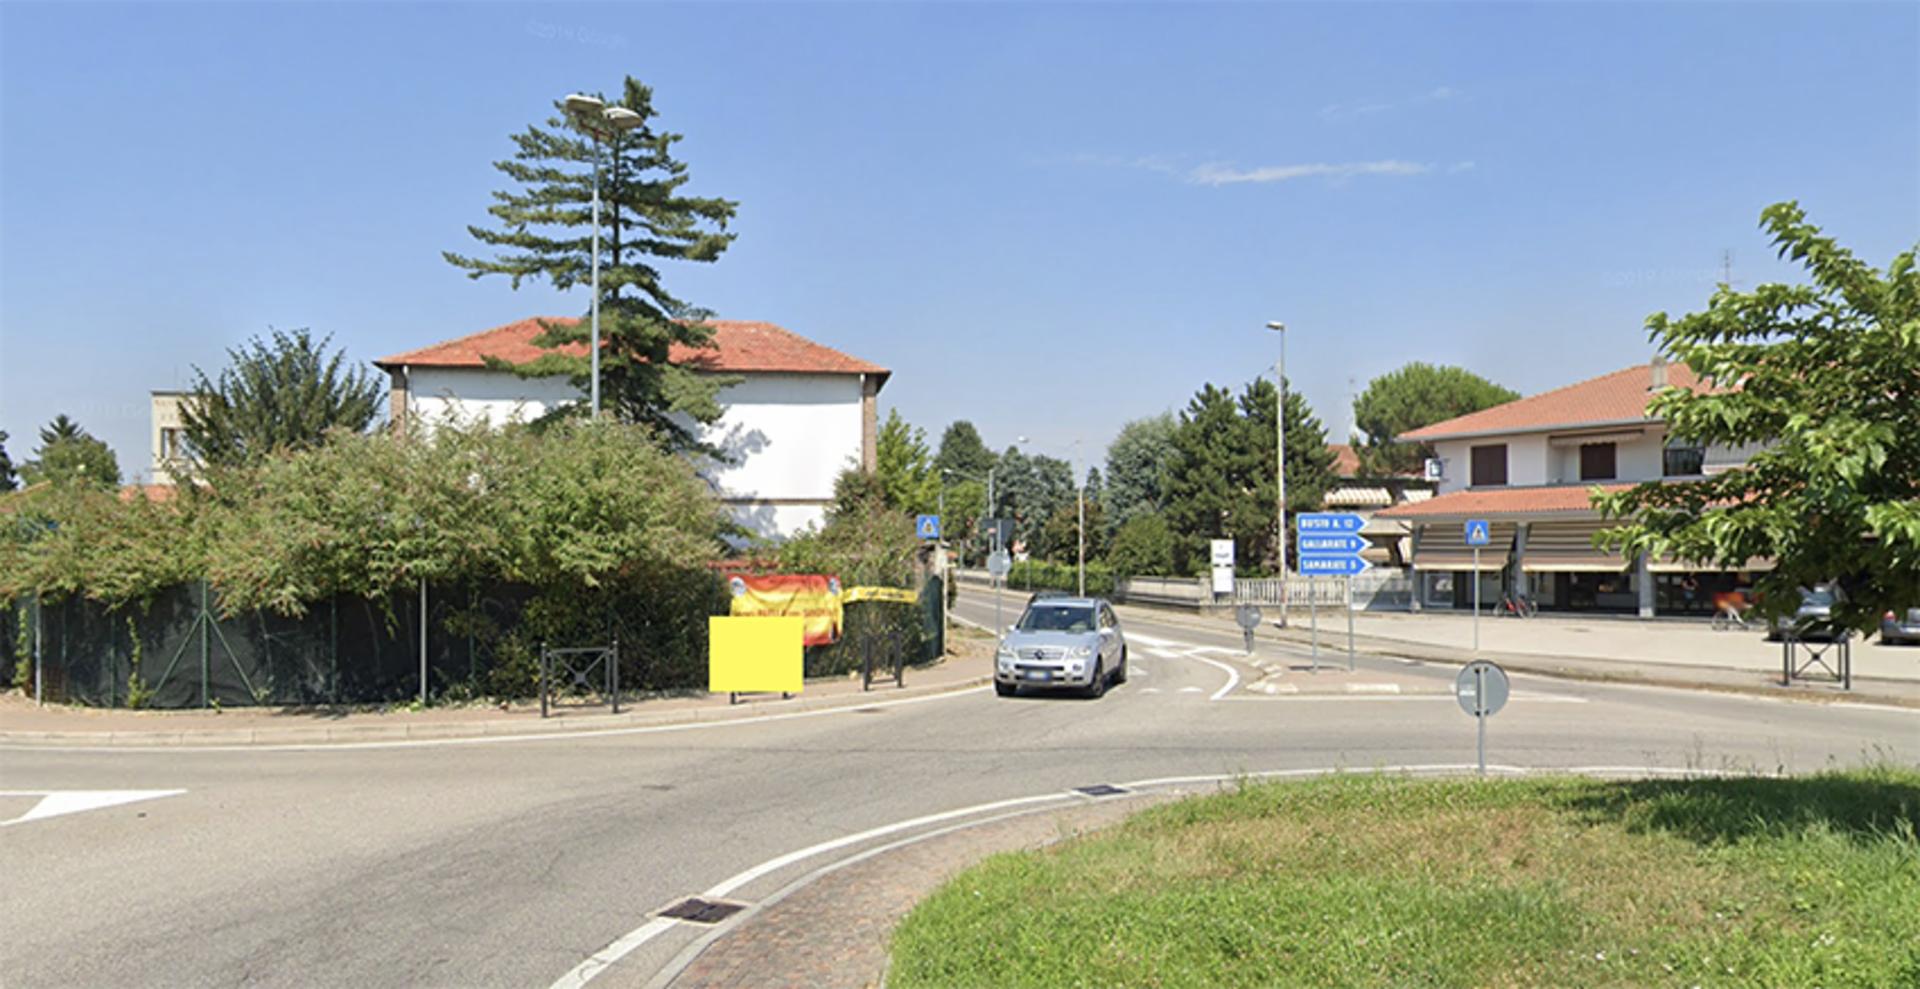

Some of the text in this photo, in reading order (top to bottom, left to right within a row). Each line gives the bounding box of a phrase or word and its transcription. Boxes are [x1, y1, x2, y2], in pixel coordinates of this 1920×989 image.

[1301, 518, 1330, 529] BUSTO
[1344, 518, 1354, 528] 12
[1302, 539, 1347, 549] GALLARATE
[1302, 559, 1347, 570] SAMARATE
